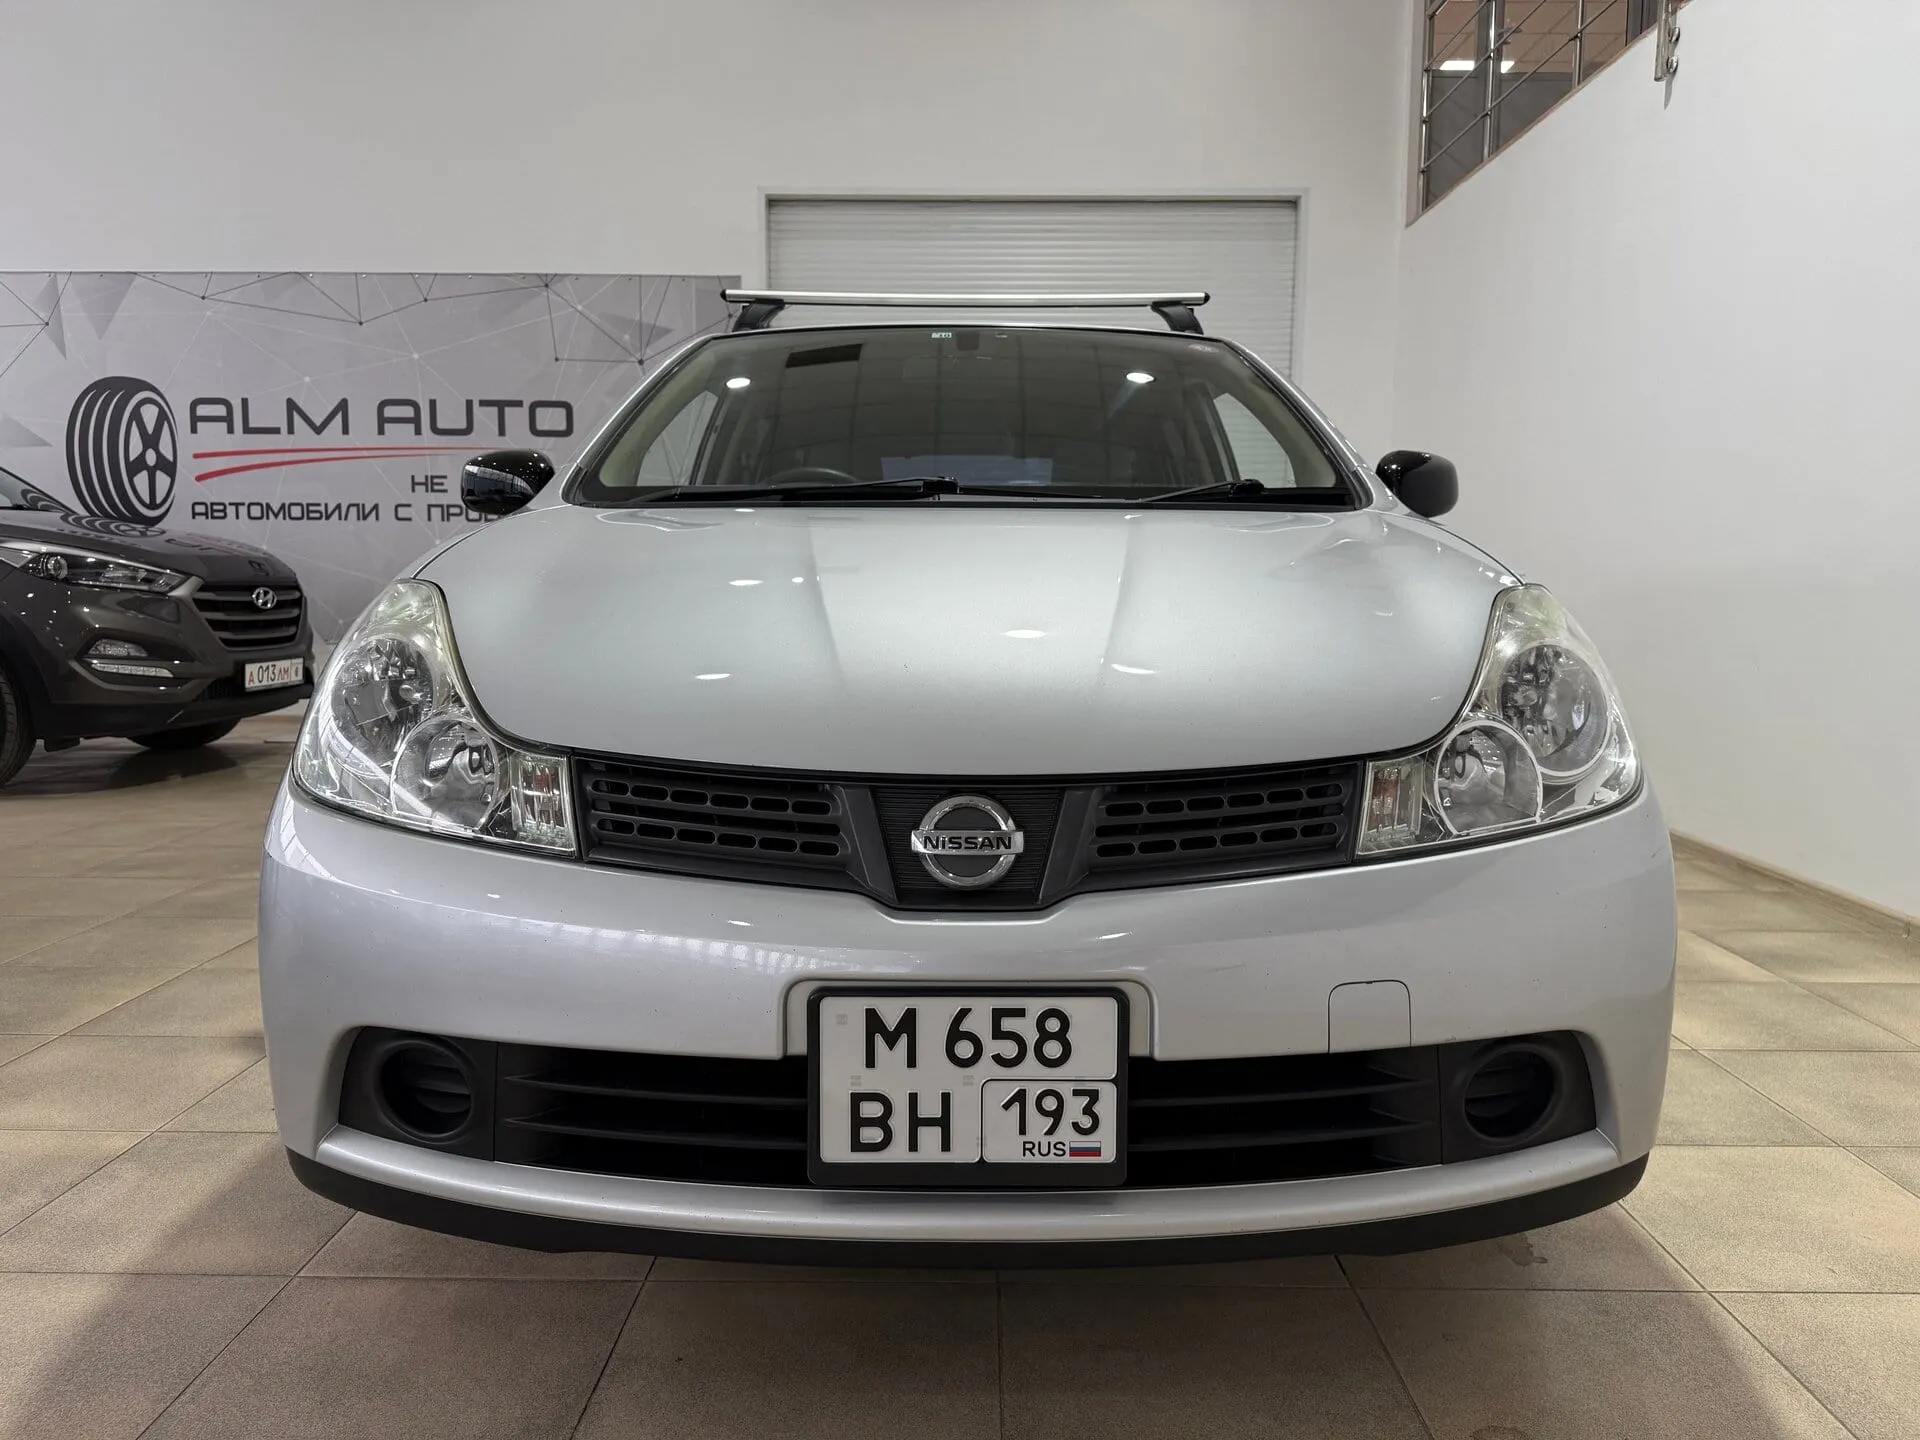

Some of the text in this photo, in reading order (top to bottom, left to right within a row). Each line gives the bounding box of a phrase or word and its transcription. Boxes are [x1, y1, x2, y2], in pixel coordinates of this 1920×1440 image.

[189, 397, 575, 438] ALM AUTO
[411, 474, 448, 493] НЕ
[191, 501, 380, 522] АВТОМОБИЛИ
[394, 503, 413, 522] С
[865, 1006, 1073, 1068] М 658
[850, 1091, 952, 1153] ВН
[1001, 1088, 1100, 1136] 193
[1022, 1141, 1067, 1157] RUS
